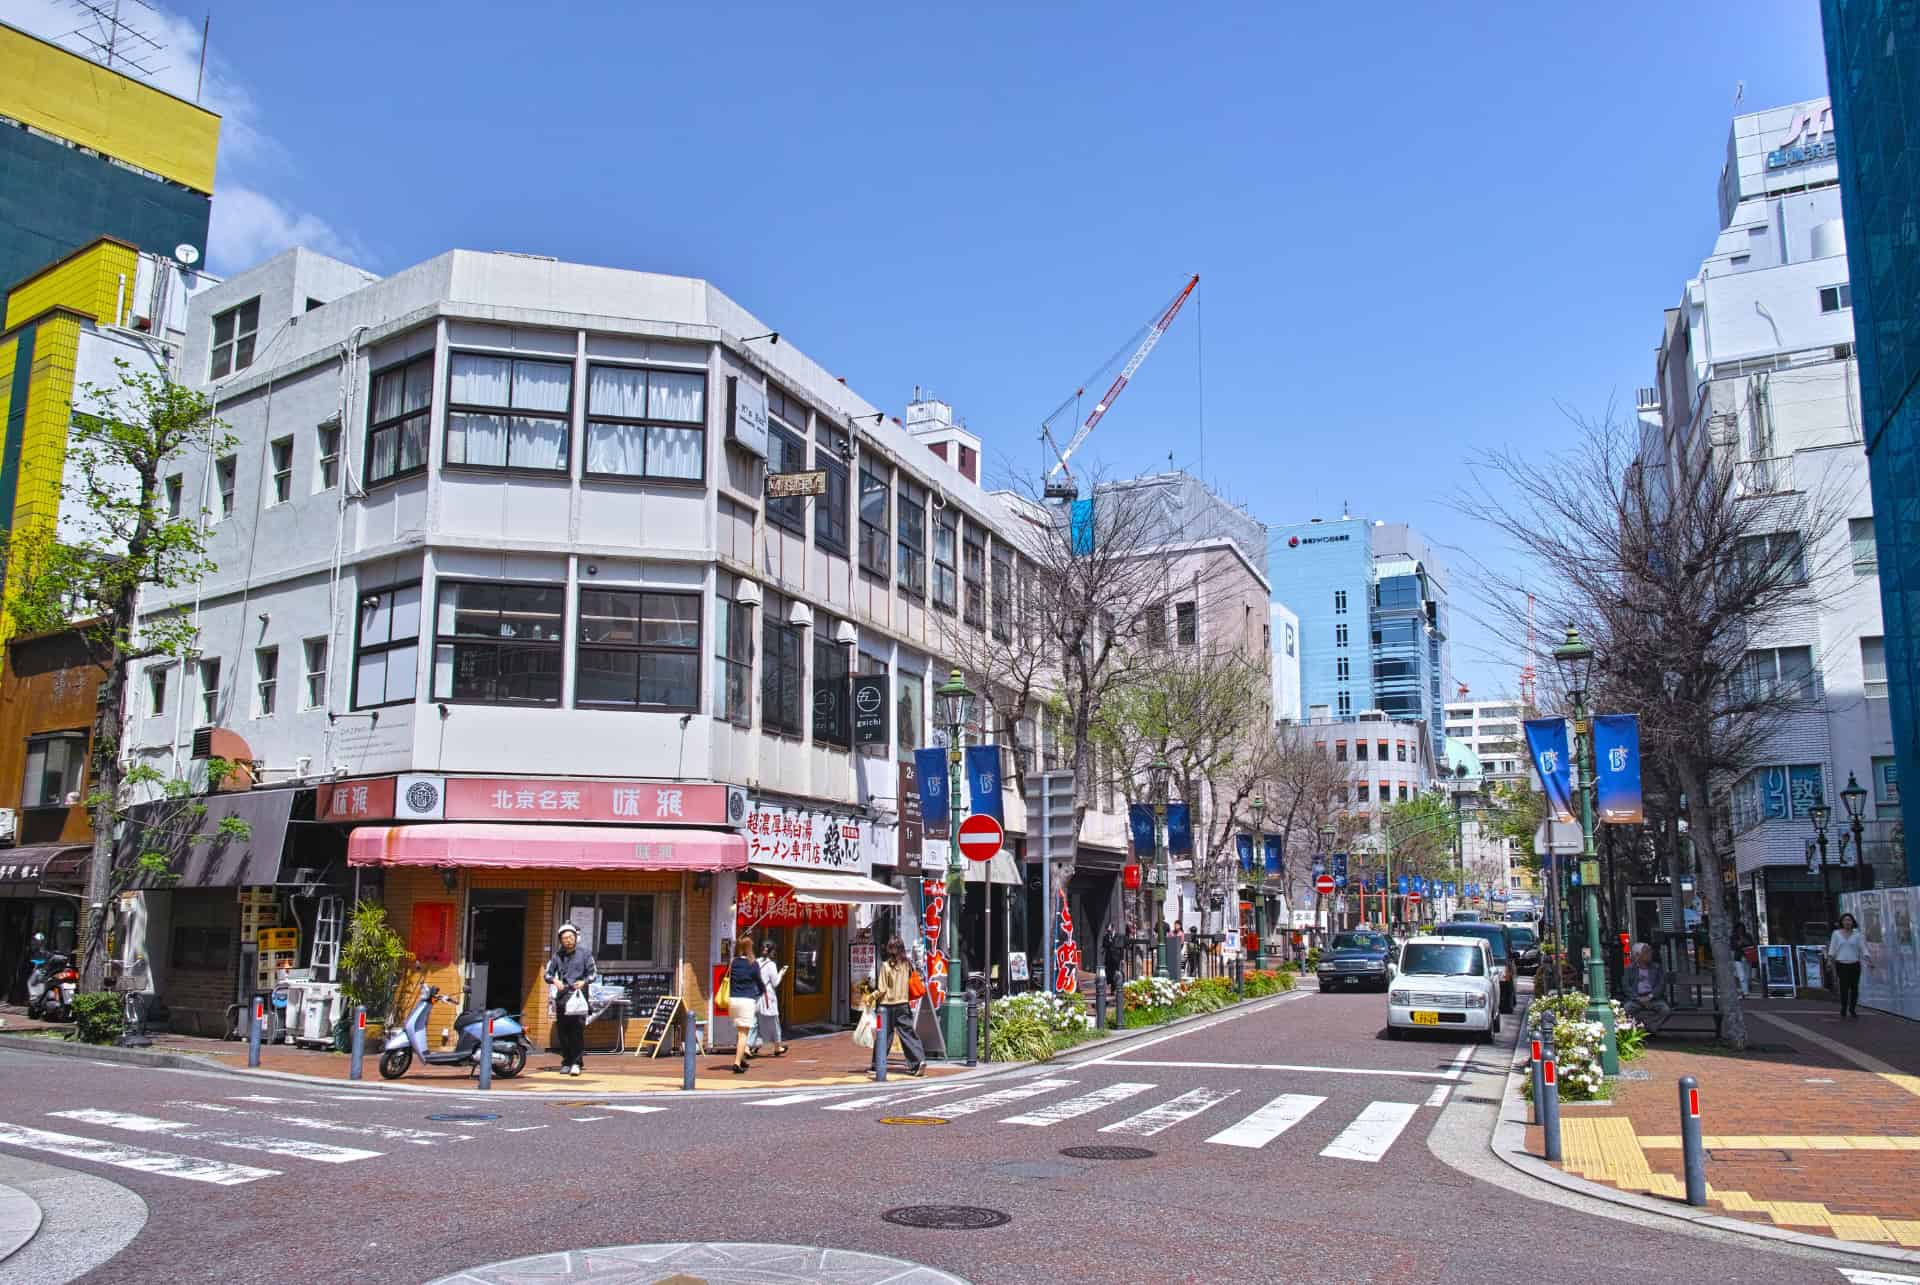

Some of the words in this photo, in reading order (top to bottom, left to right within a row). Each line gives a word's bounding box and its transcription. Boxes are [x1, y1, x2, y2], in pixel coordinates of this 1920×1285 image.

[492, 789, 581, 810] 北京名菜
[750, 838, 821, 865] ラーメン専門店
